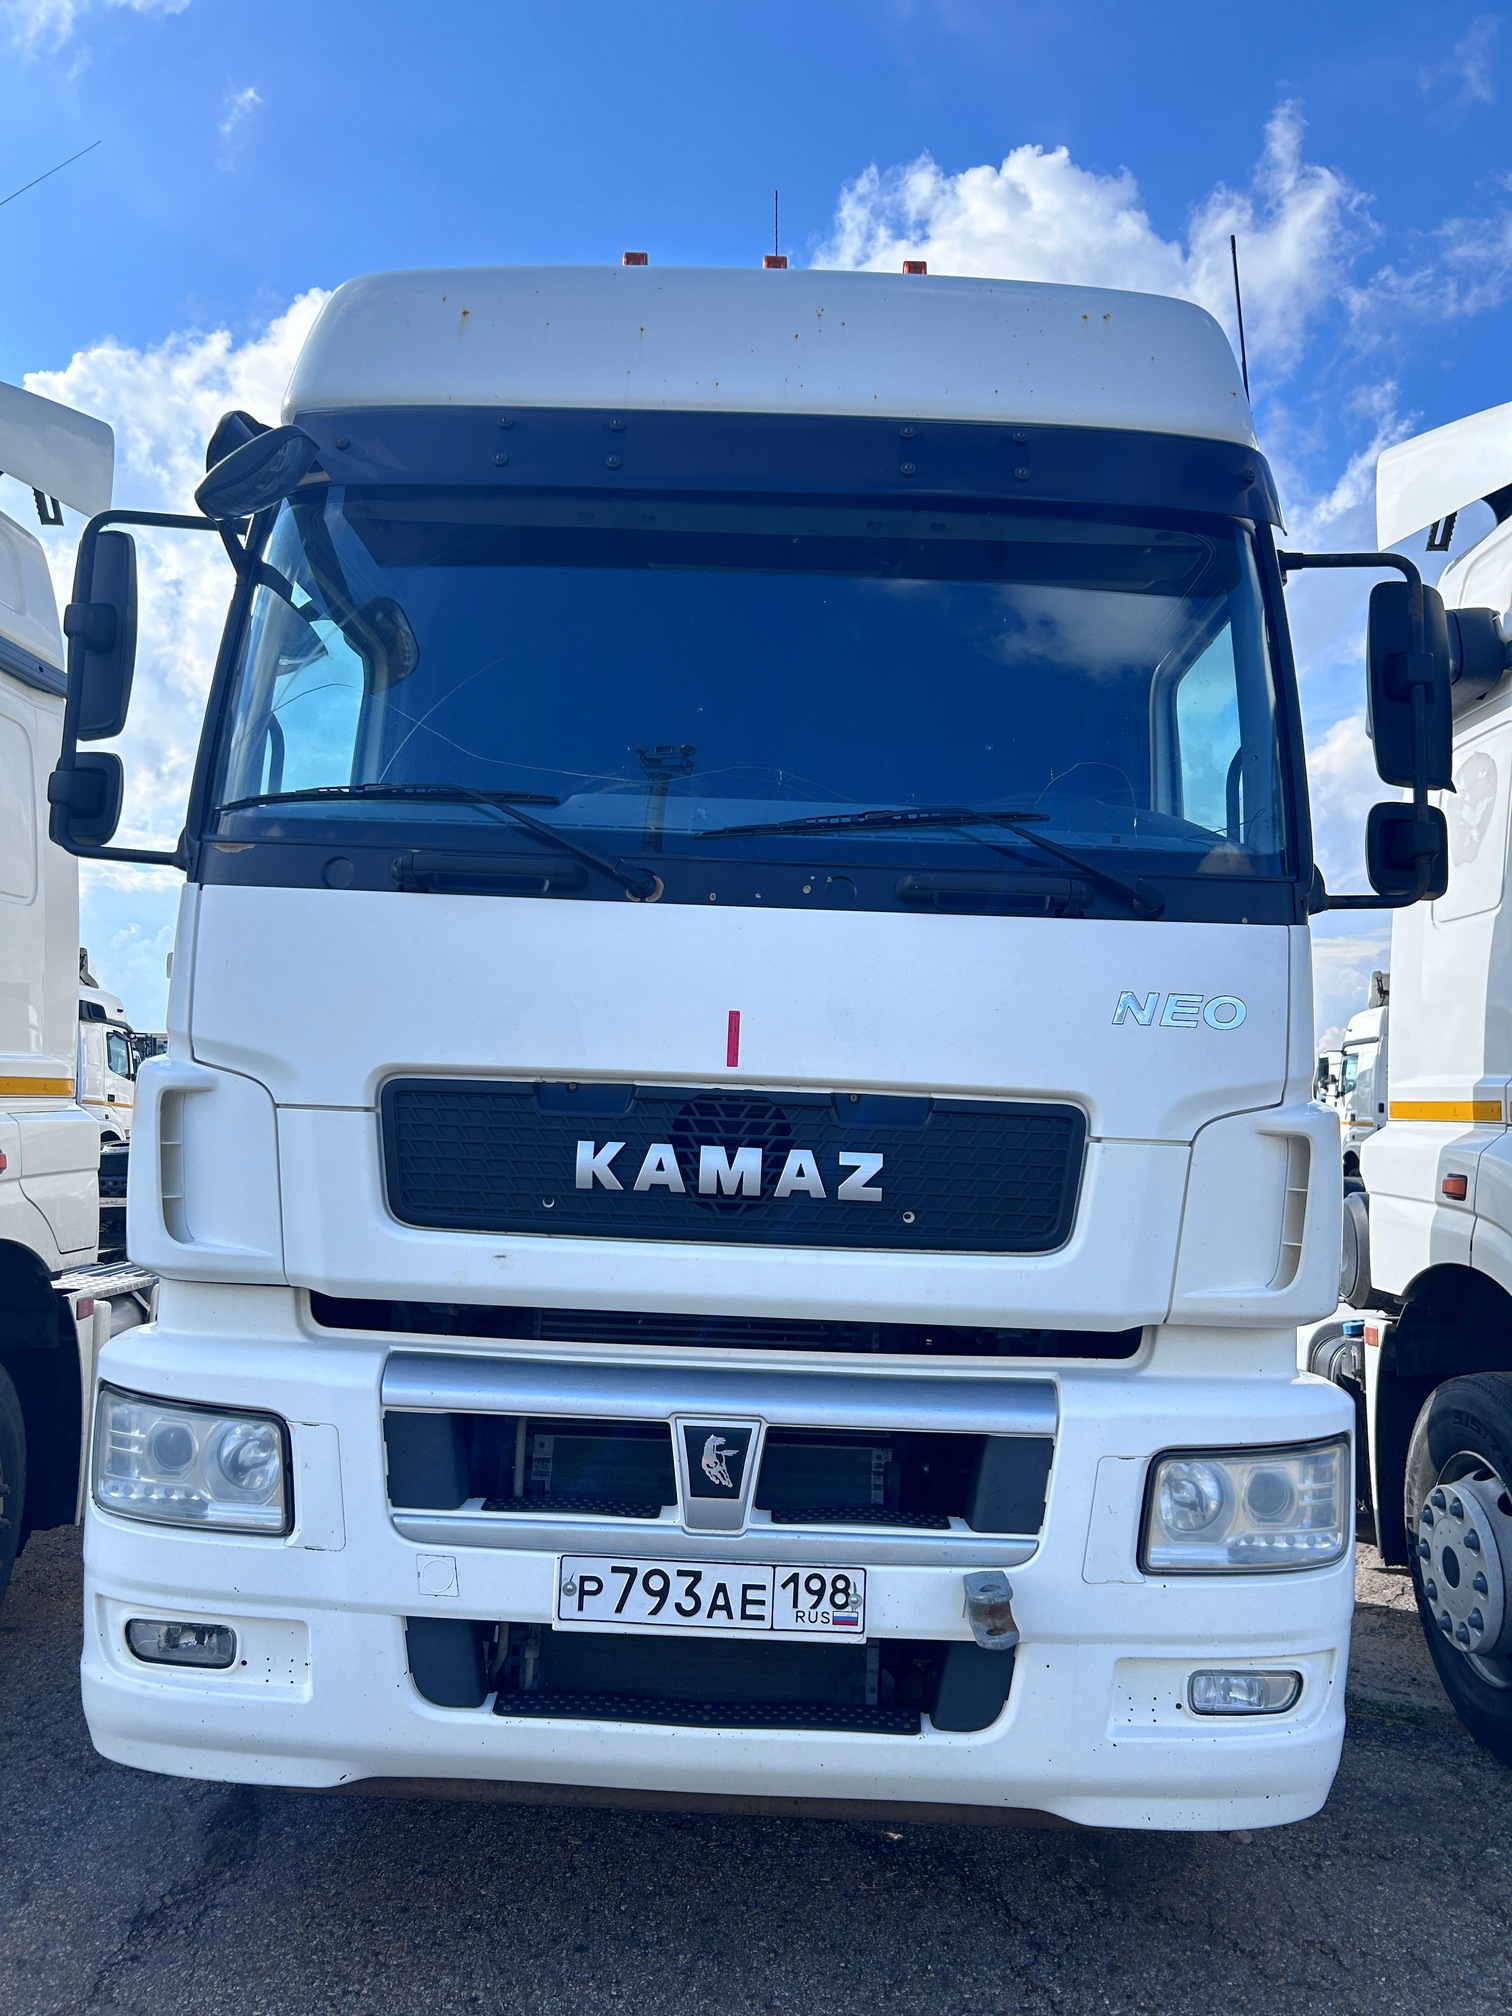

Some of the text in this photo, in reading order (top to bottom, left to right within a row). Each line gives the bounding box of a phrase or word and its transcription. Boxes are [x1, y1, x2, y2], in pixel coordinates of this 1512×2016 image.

[1111, 991, 1248, 1031] NEO
[575, 1140, 884, 1202] KAMAZ
[780, 1572, 851, 1610] 198
[795, 1610, 831, 1625] RUS
